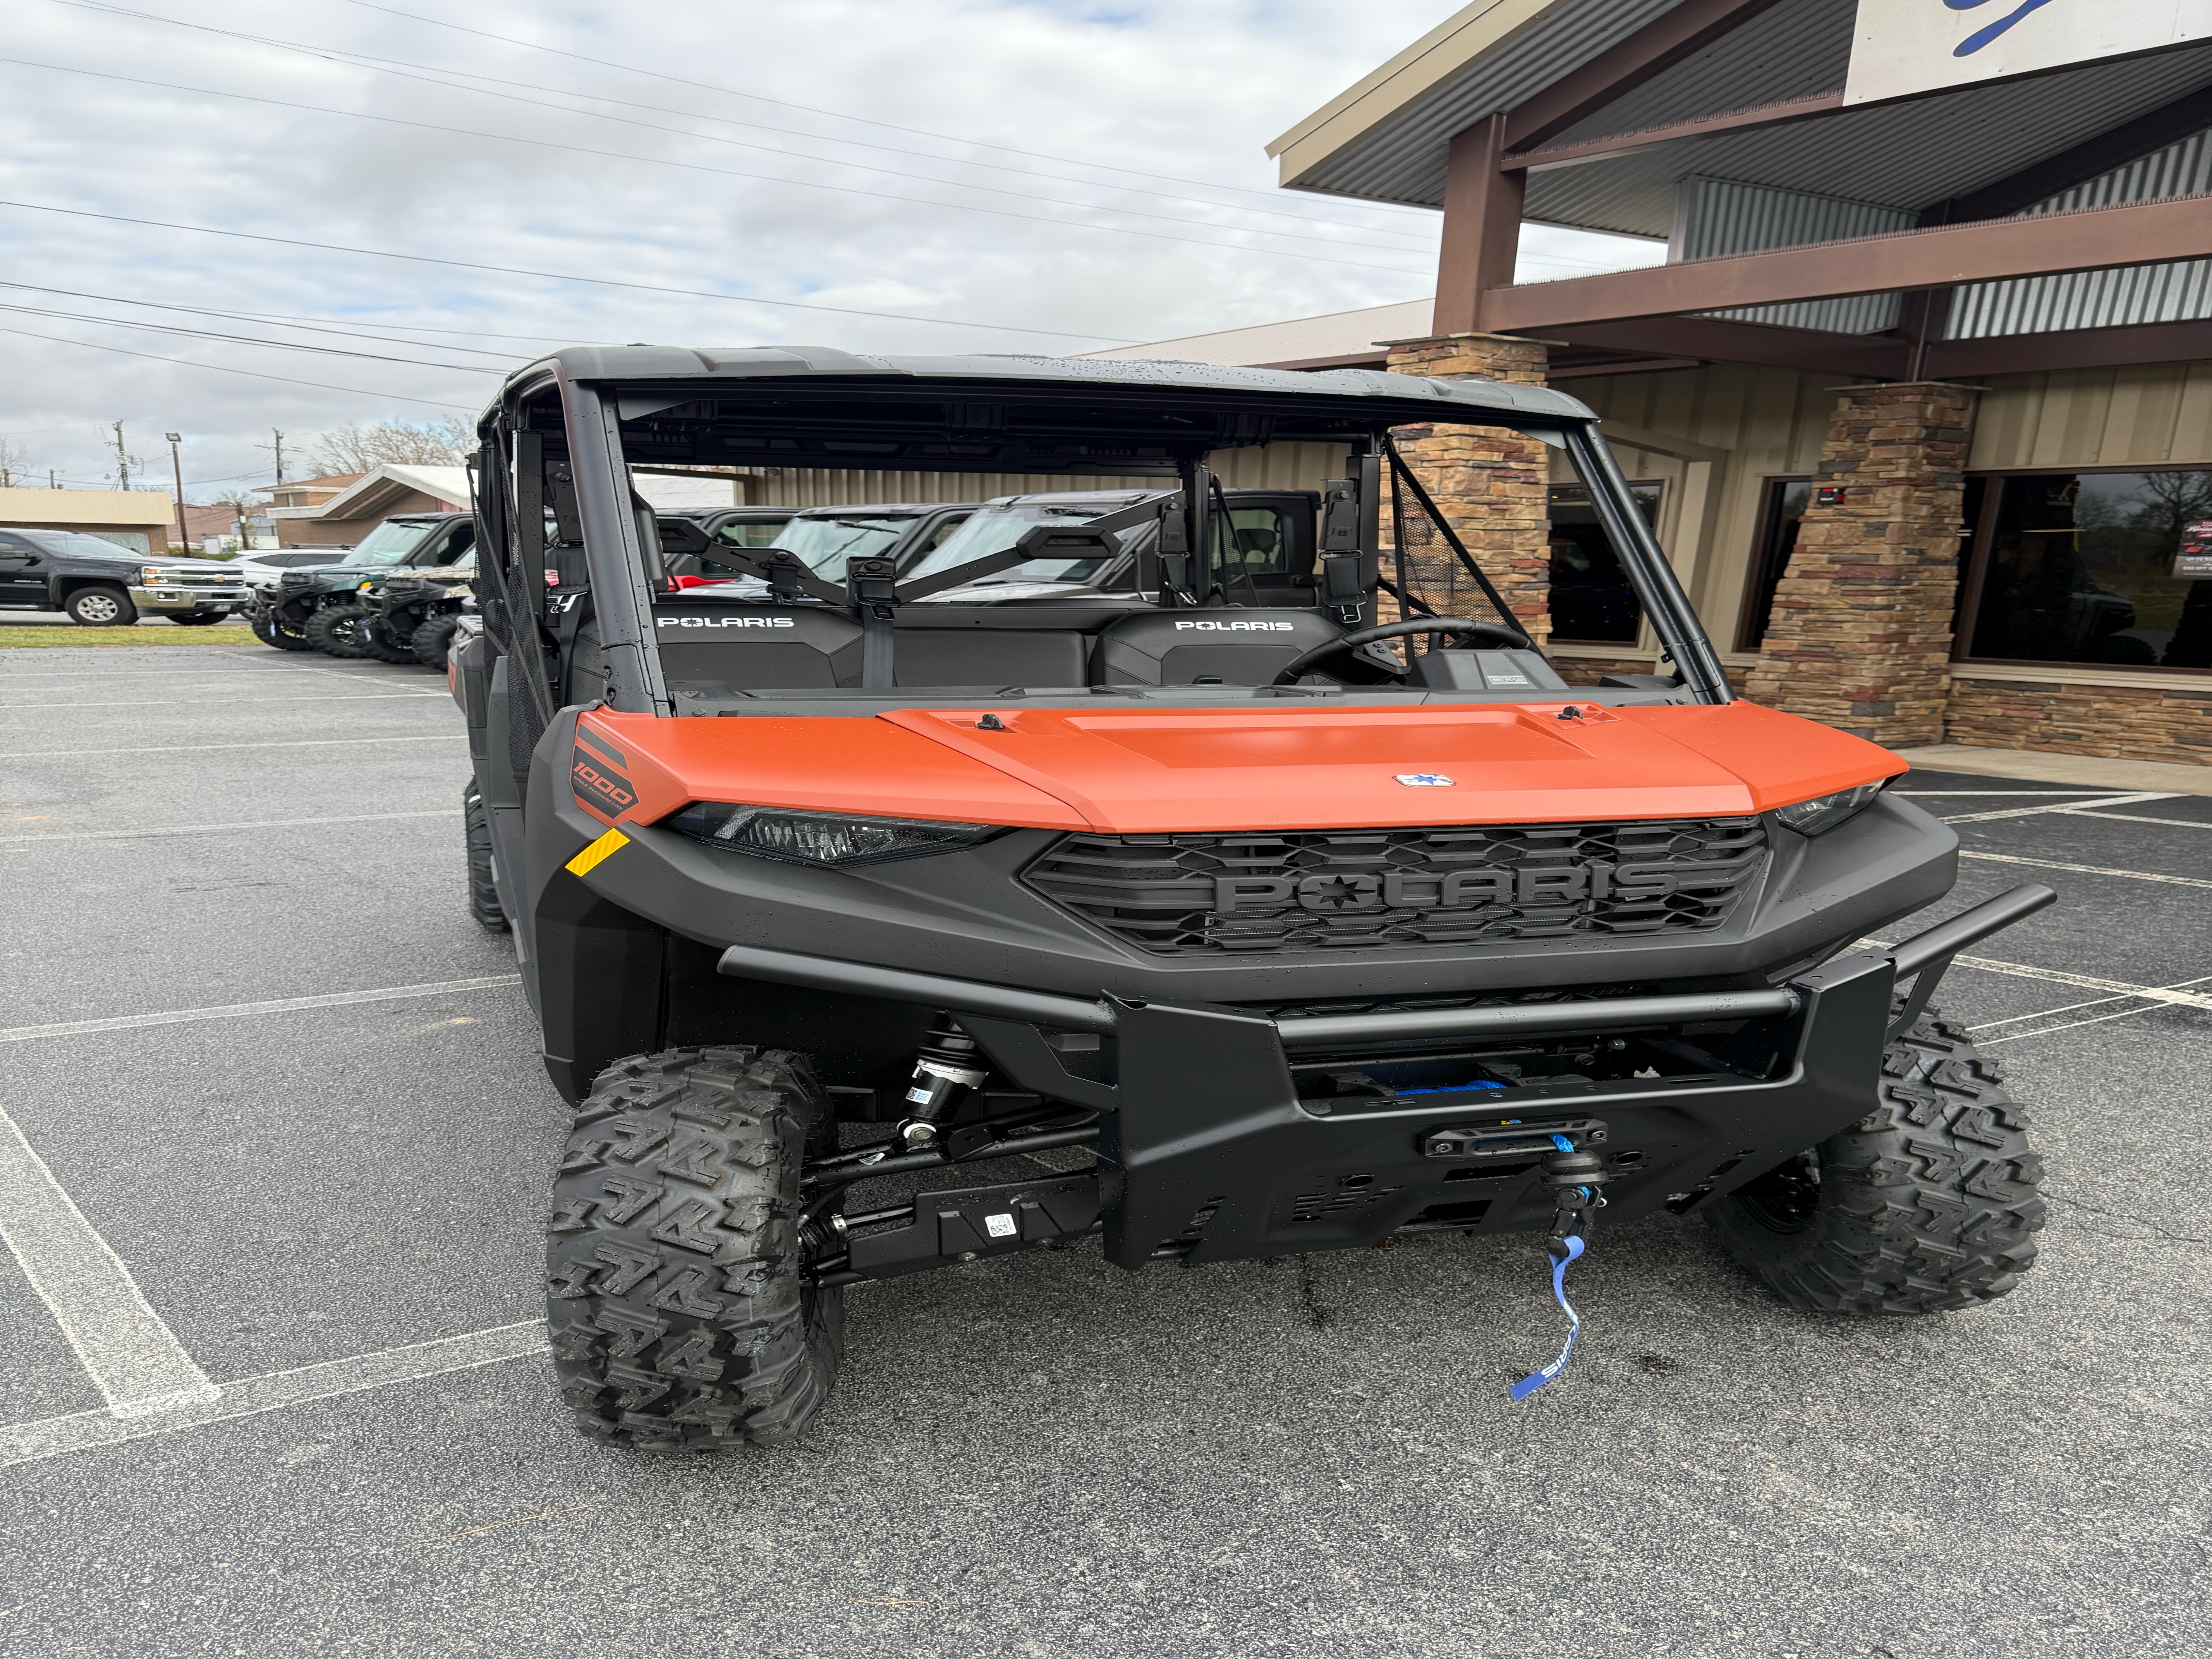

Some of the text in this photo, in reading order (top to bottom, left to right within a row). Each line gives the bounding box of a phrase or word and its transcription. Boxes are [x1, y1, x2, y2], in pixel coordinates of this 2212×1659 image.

[657, 618, 794, 627] POLARIS
[1175, 622, 1293, 630] POLARIS
[573, 762, 633, 805] 1000
[573, 776, 623, 810] SINGLE OVERHEAD CAM
[1213, 860, 1678, 912] POLARIS
